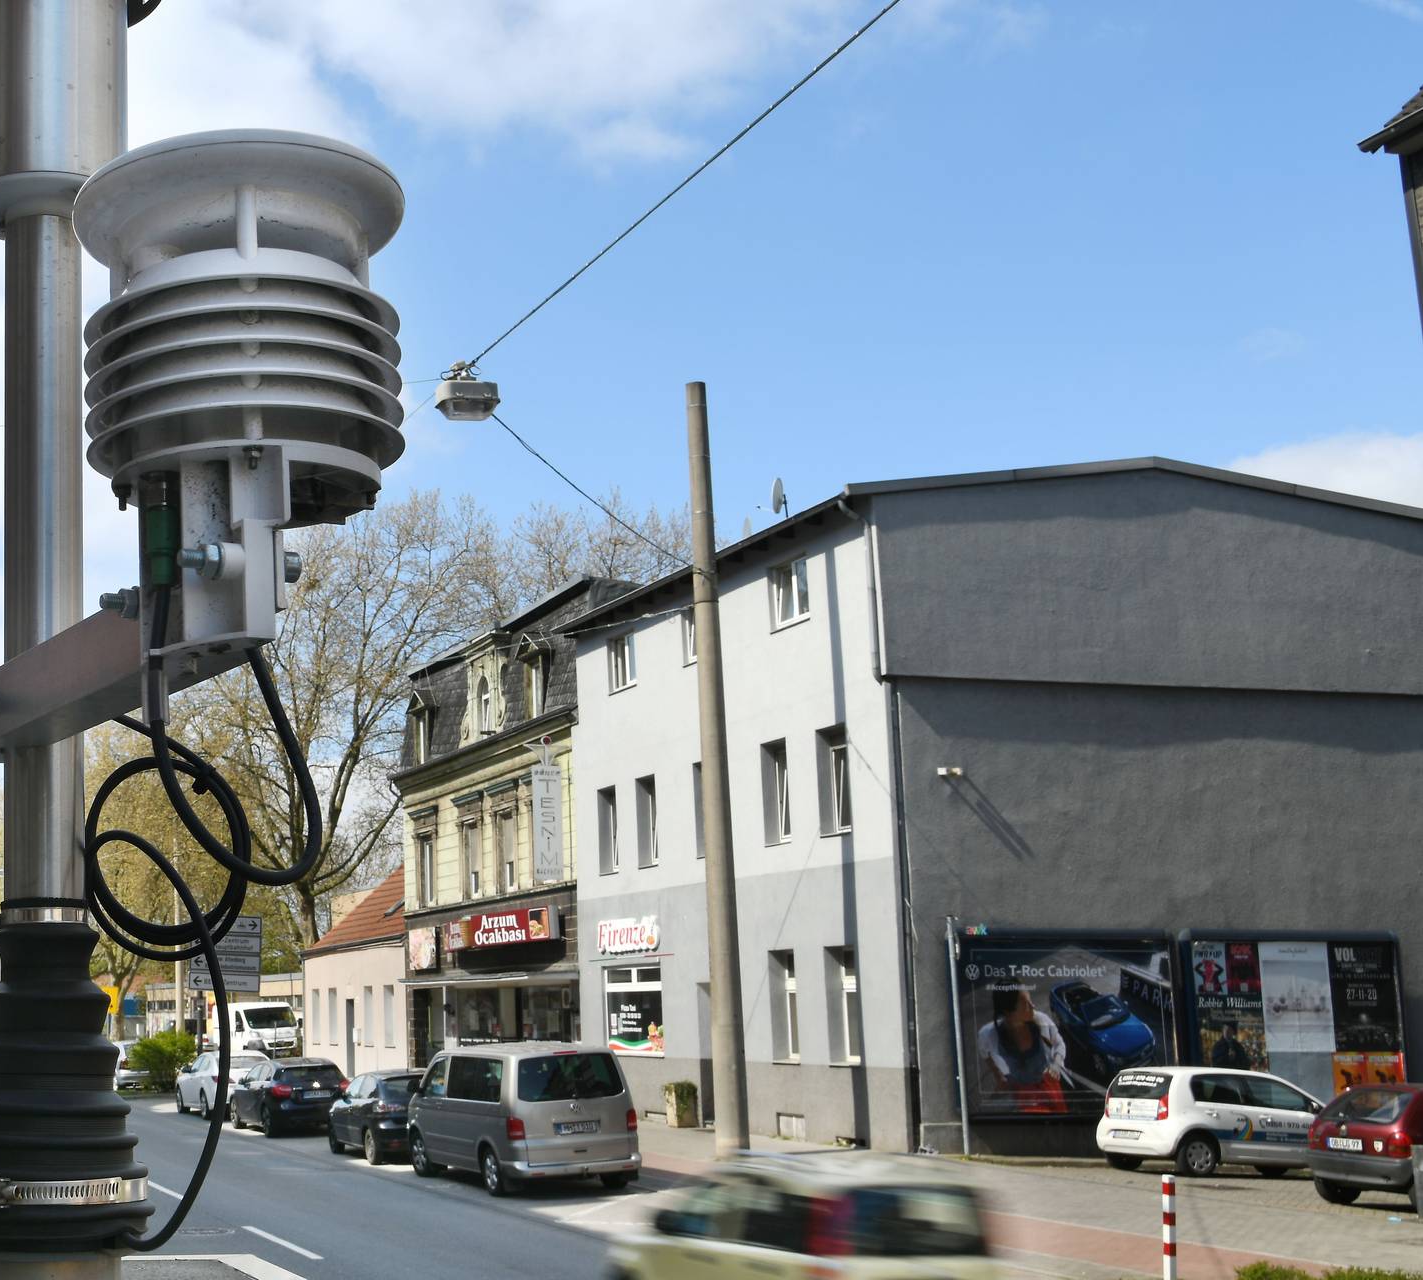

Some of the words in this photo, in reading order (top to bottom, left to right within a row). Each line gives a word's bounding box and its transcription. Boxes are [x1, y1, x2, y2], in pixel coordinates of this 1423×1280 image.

[480, 914, 519, 932] Arzum
[598, 923, 646, 949] Firenze
[984, 965, 1006, 977] Das
[1009, 965, 1045, 977] T-Roc
[1198, 997, 1223, 1008] Robbie
[1226, 996, 1263, 1008] Williams
